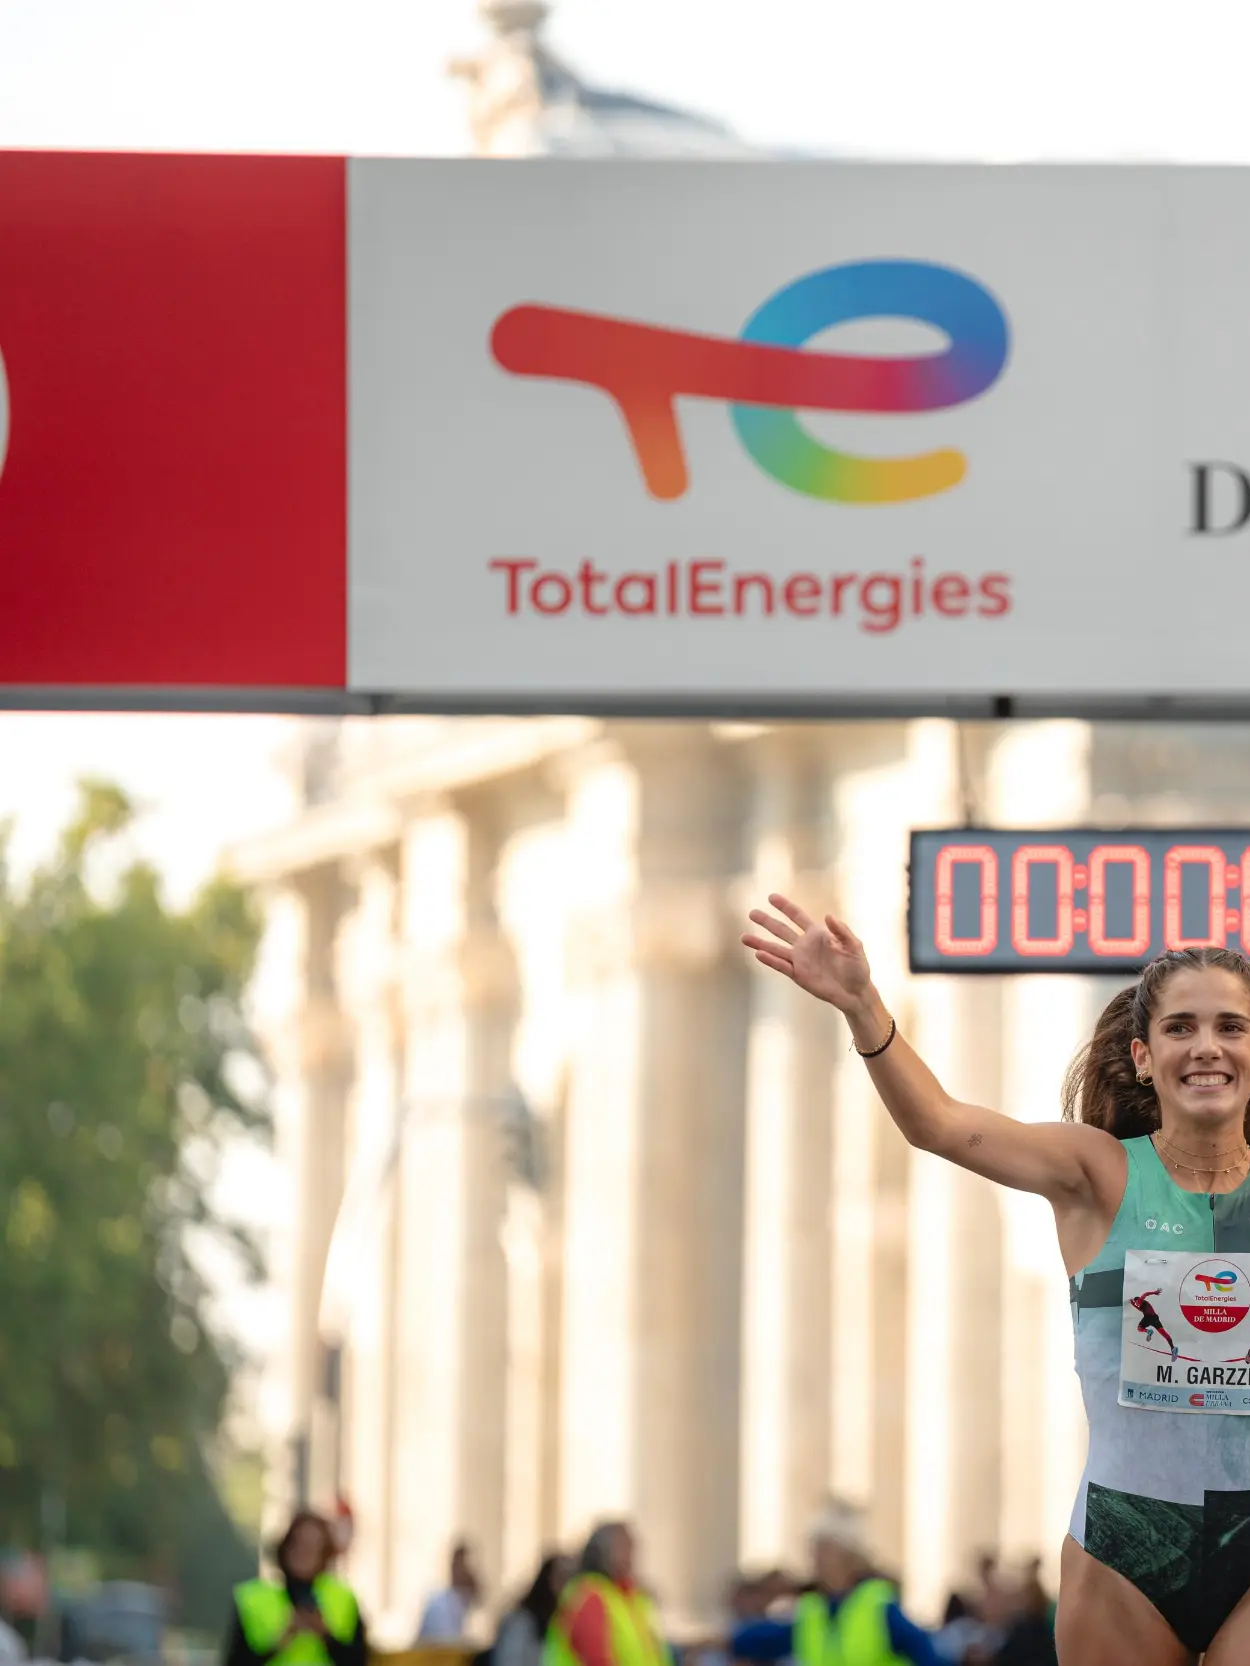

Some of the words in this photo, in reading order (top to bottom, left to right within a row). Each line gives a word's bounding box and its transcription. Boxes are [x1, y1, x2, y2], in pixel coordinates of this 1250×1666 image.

[488, 557, 1013, 633] TotalEnergies
[1145, 1218, 1183, 1235] OAC
[1195, 1295, 1237, 1303] TotalEnergies
[1156, 1366, 1179, 1384] M.
[1139, 1391, 1179, 1403] MADRID
